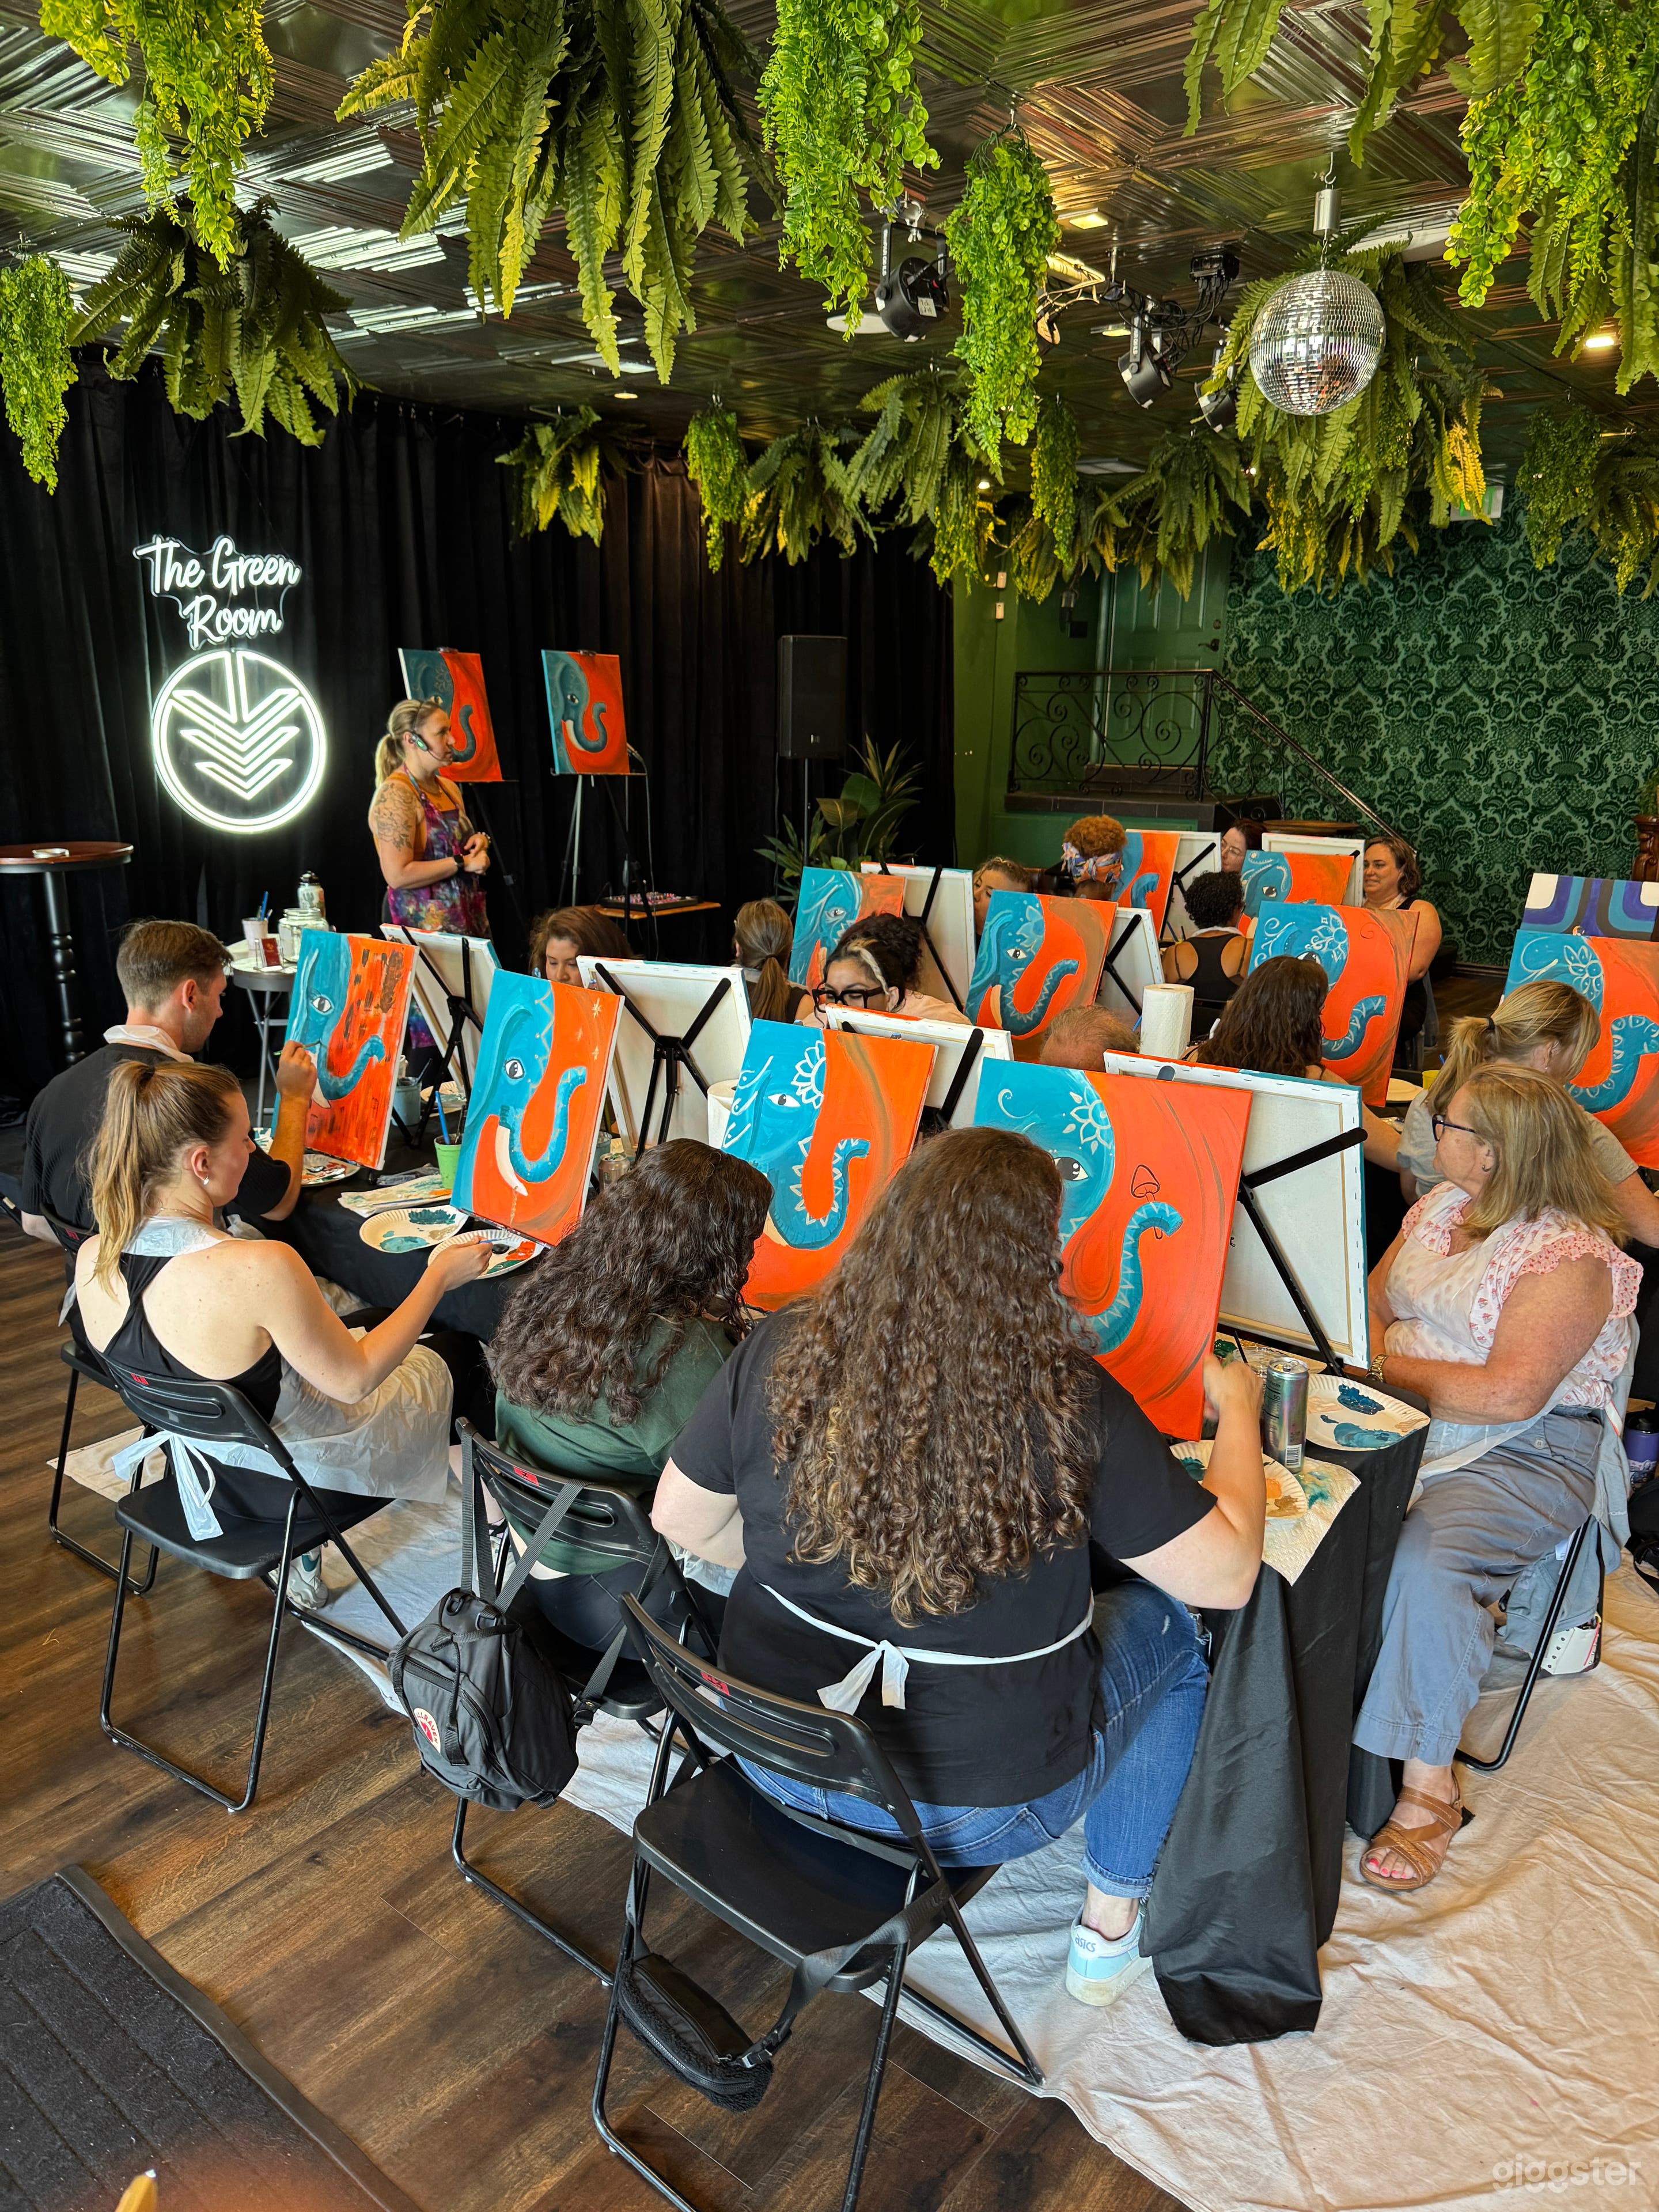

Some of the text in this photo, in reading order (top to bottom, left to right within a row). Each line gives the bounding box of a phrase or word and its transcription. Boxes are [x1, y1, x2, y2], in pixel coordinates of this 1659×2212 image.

[137, 536, 300, 596] The Green
[183, 596, 281, 648] Room
